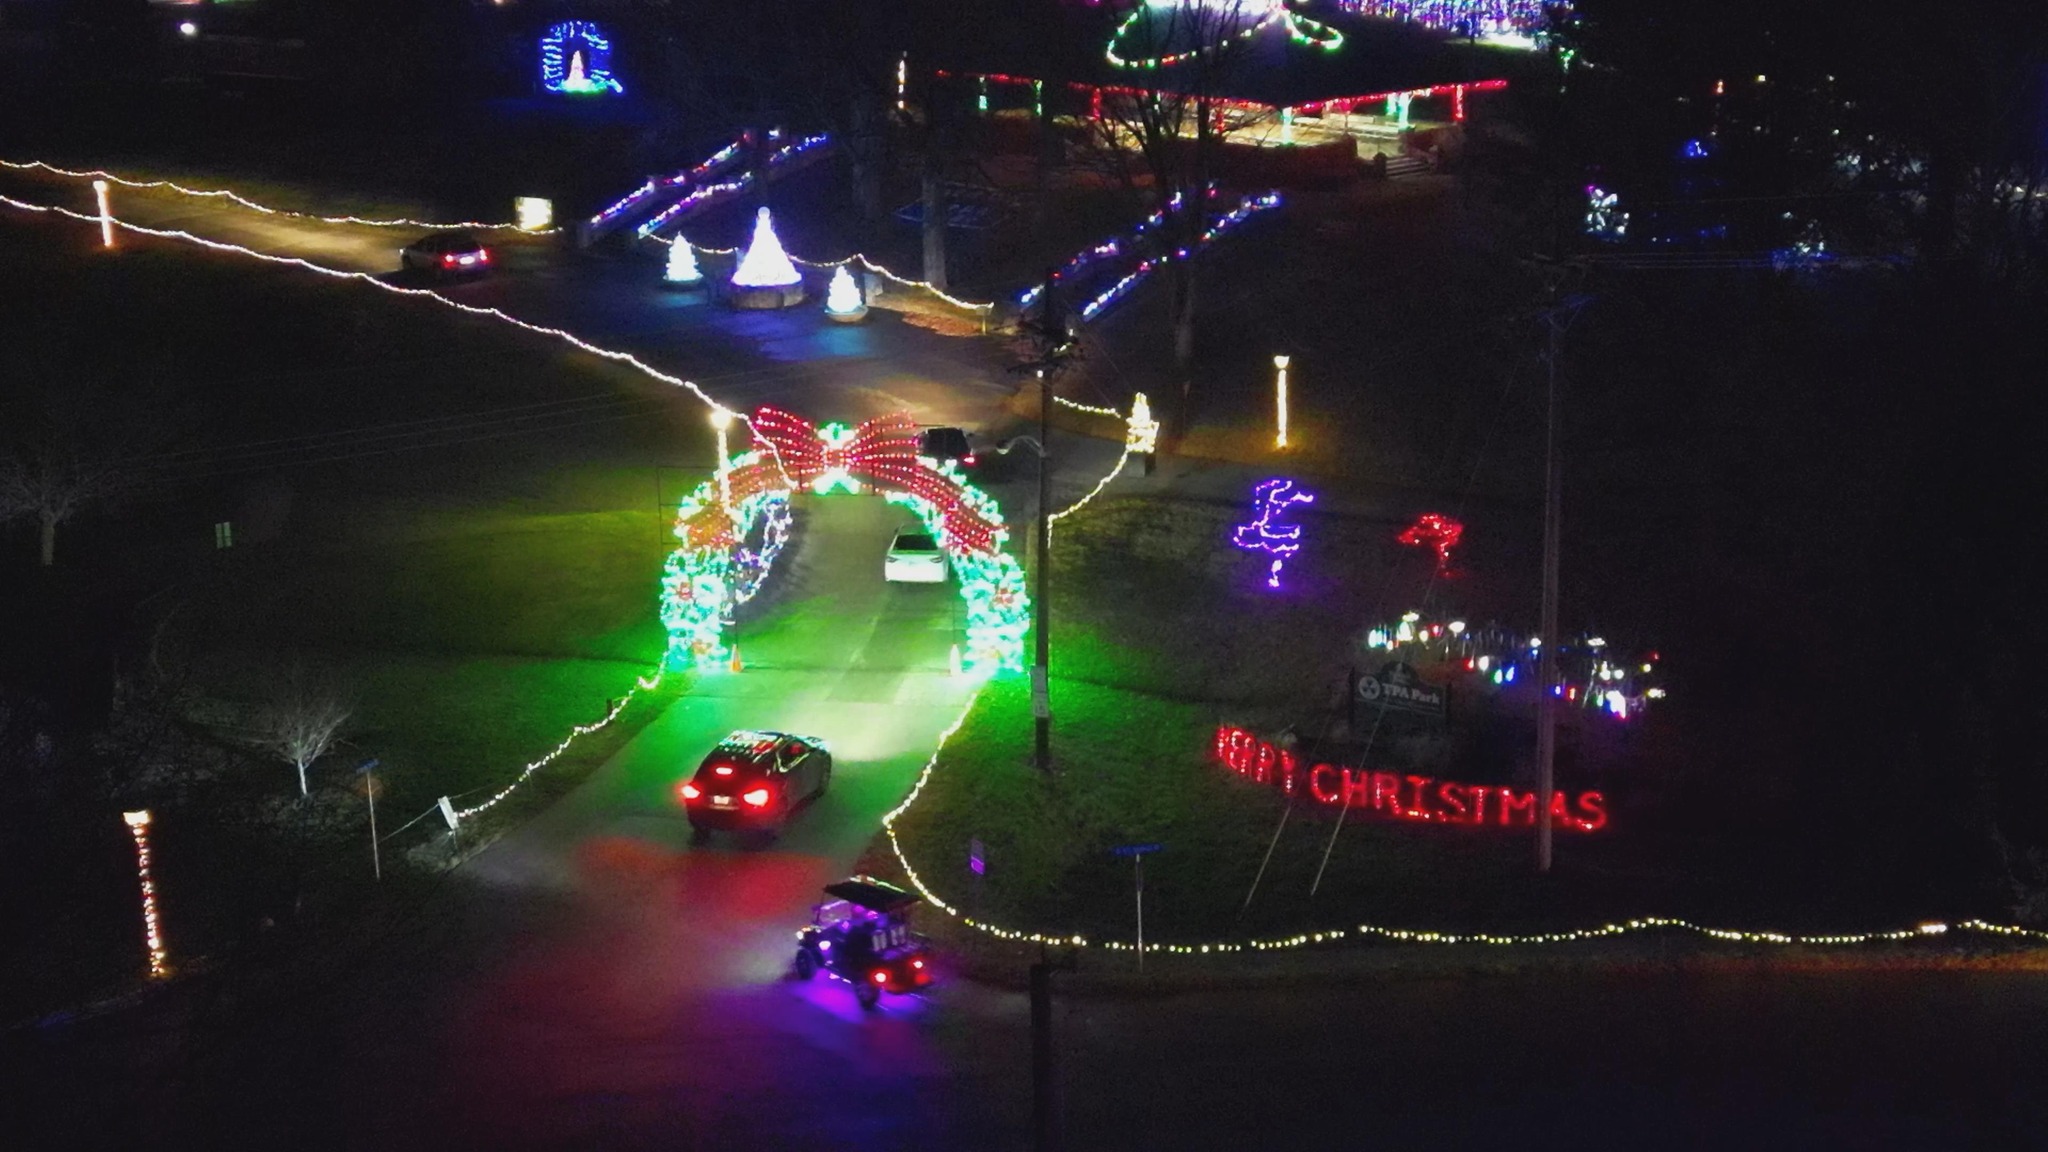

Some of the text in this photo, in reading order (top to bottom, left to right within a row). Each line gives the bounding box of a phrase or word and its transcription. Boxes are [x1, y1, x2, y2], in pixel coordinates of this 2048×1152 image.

[1382, 683, 1440, 705] TPA Park
[1310, 764, 1607, 832] CHRISTMAS
